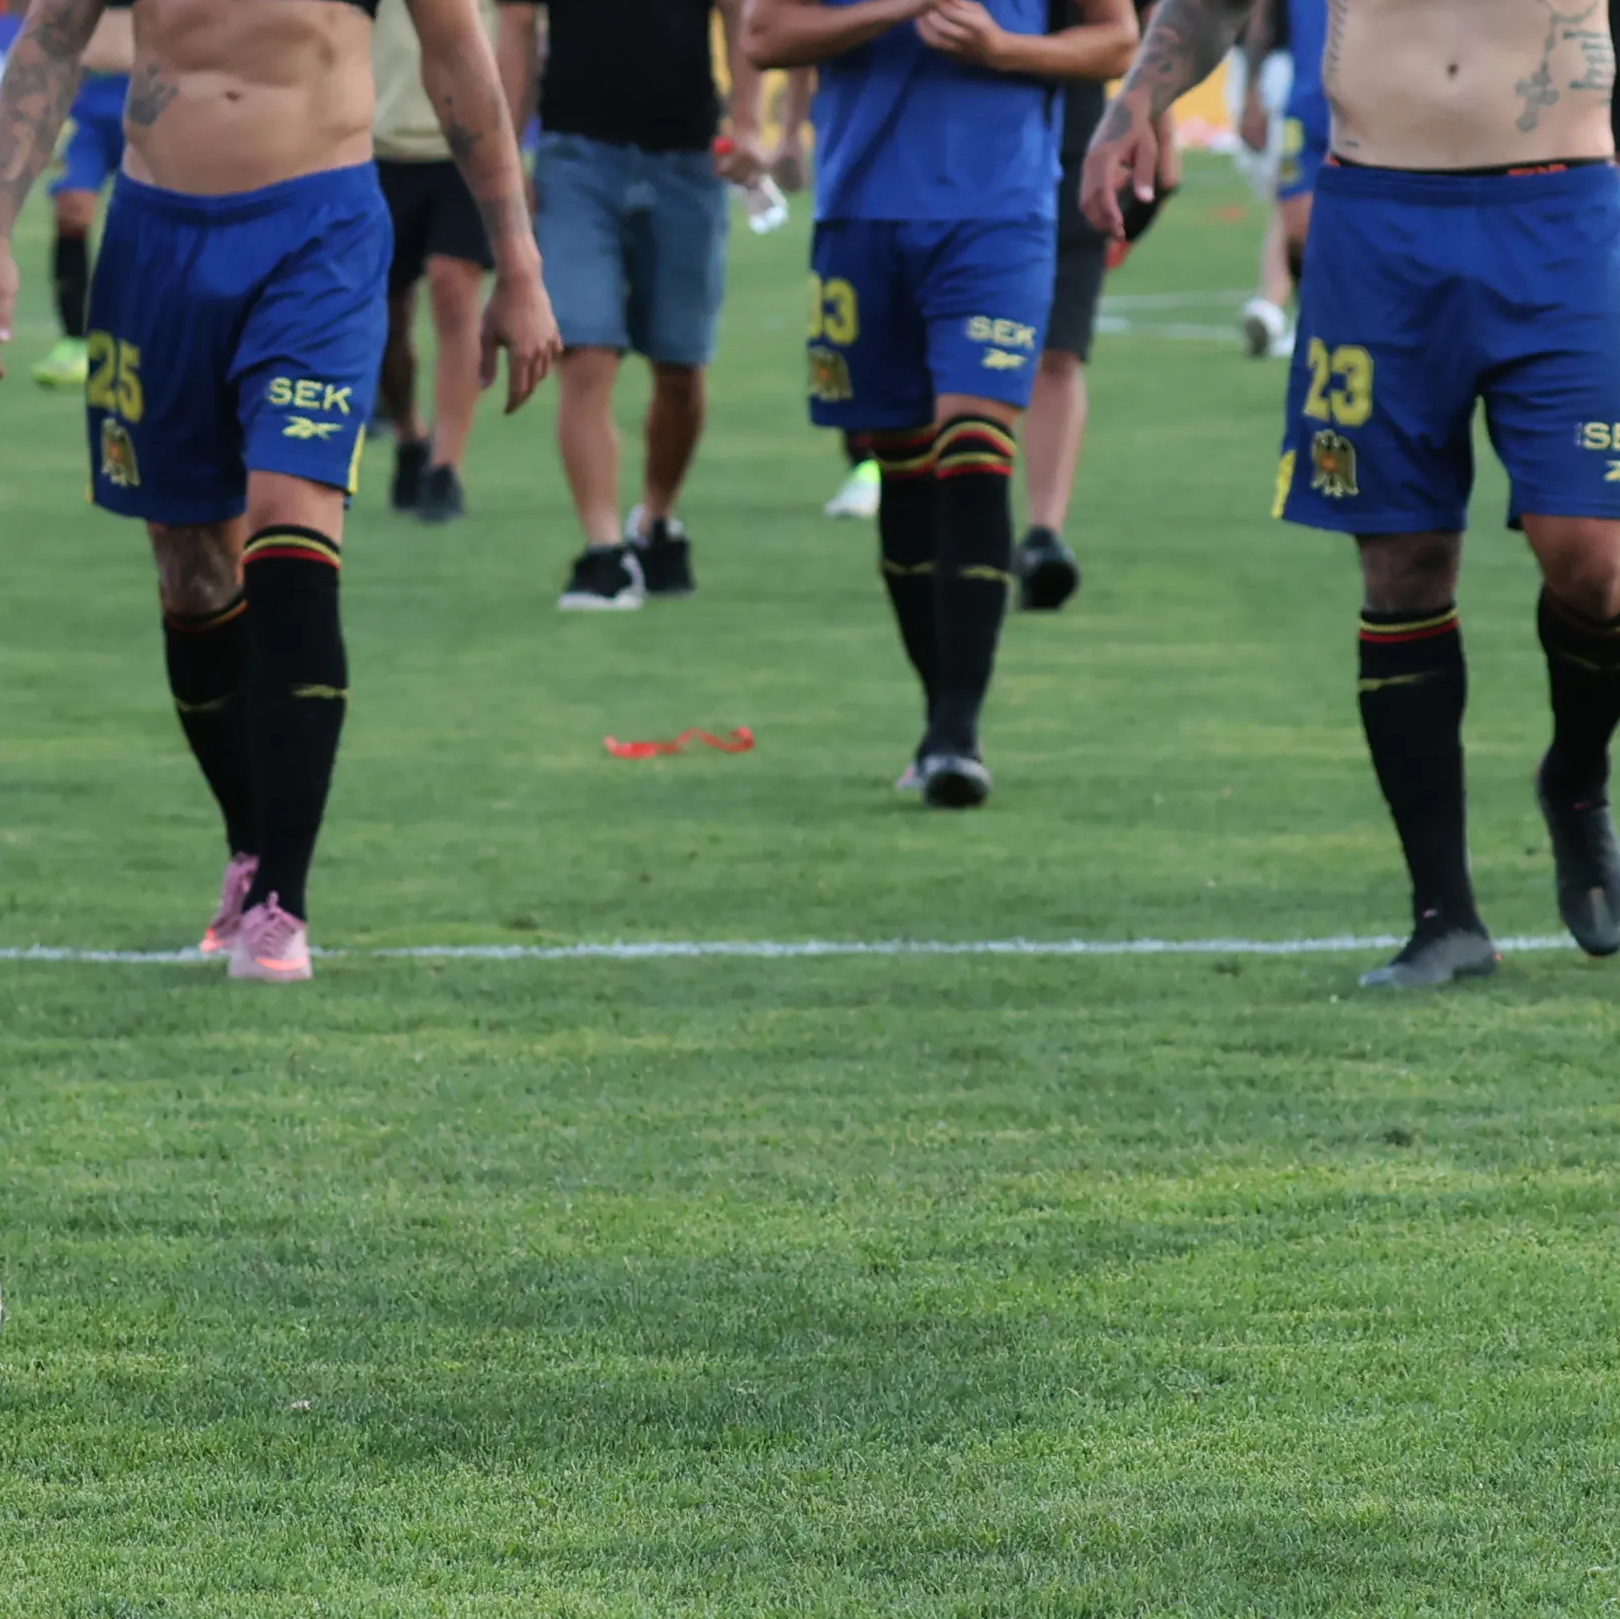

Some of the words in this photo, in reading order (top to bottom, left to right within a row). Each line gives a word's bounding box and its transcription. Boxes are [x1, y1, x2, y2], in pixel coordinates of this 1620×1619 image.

[966, 315, 1037, 350] SEK
[86, 332, 144, 423] 25
[268, 376, 353, 415] SEK
[1303, 337, 1374, 427] 23
